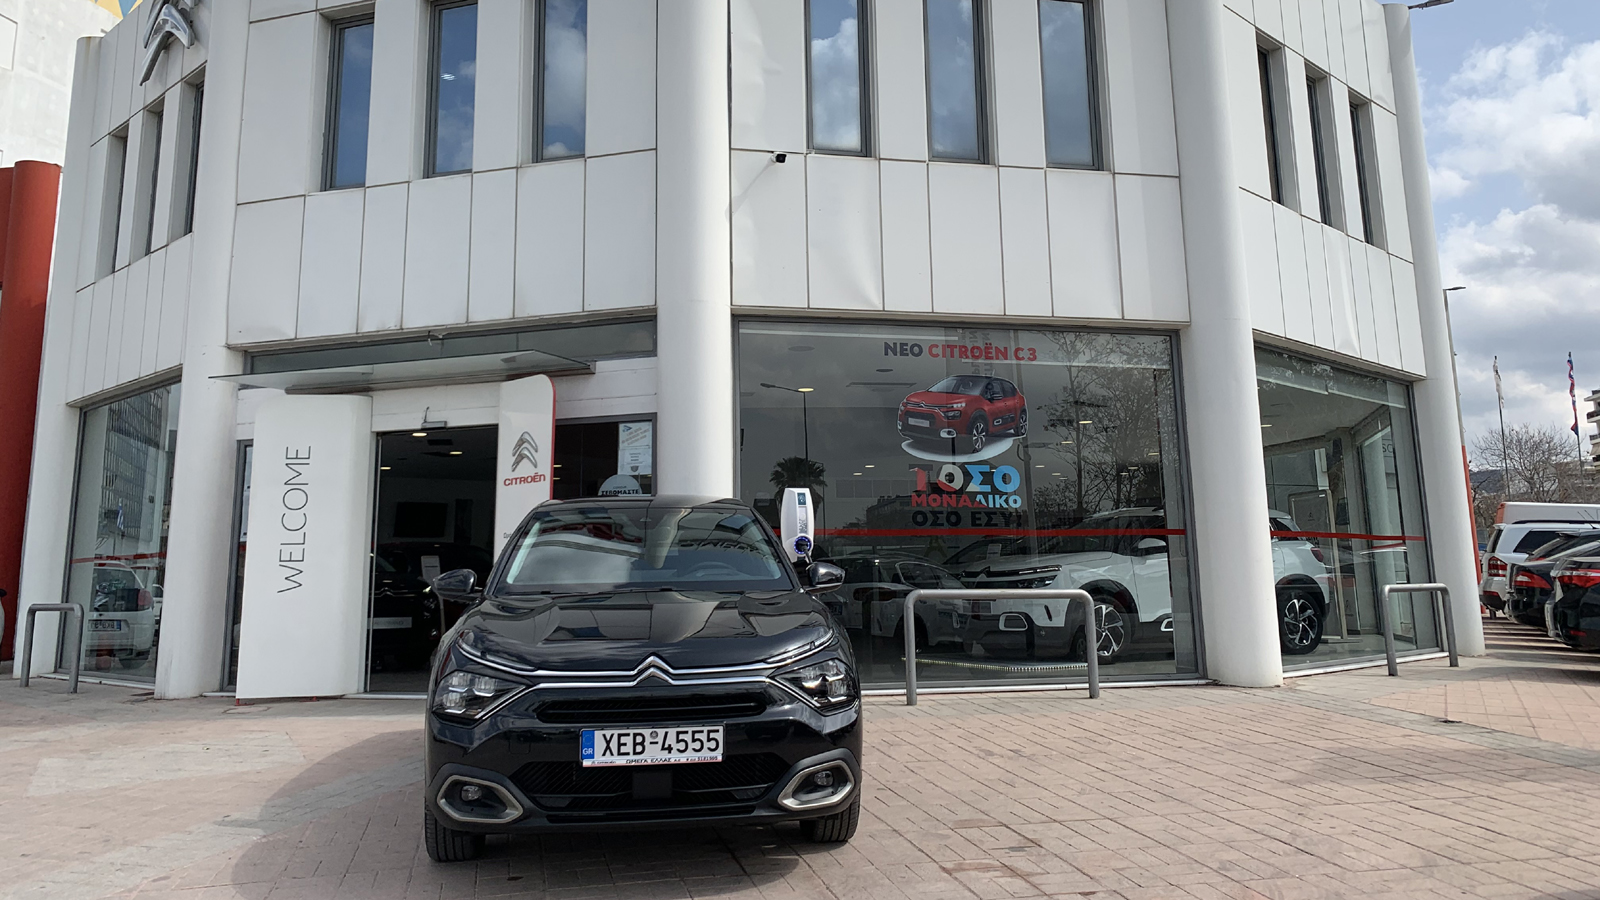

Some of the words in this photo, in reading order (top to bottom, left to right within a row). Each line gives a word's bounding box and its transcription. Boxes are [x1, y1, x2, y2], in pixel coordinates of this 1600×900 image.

[928, 343, 1008, 361] CITROËN
[503, 472, 546, 487] CITROËN
[909, 463, 1021, 492] ΤΟΣΟ
[911, 493, 1022, 509] ΜΟΝΑΔΙΚΟ
[277, 446, 311, 593] WELCOME
[911, 511, 962, 527] ΟΣΟ
[582, 747, 593, 755] GR
[601, 729, 720, 757] XEB-4555
